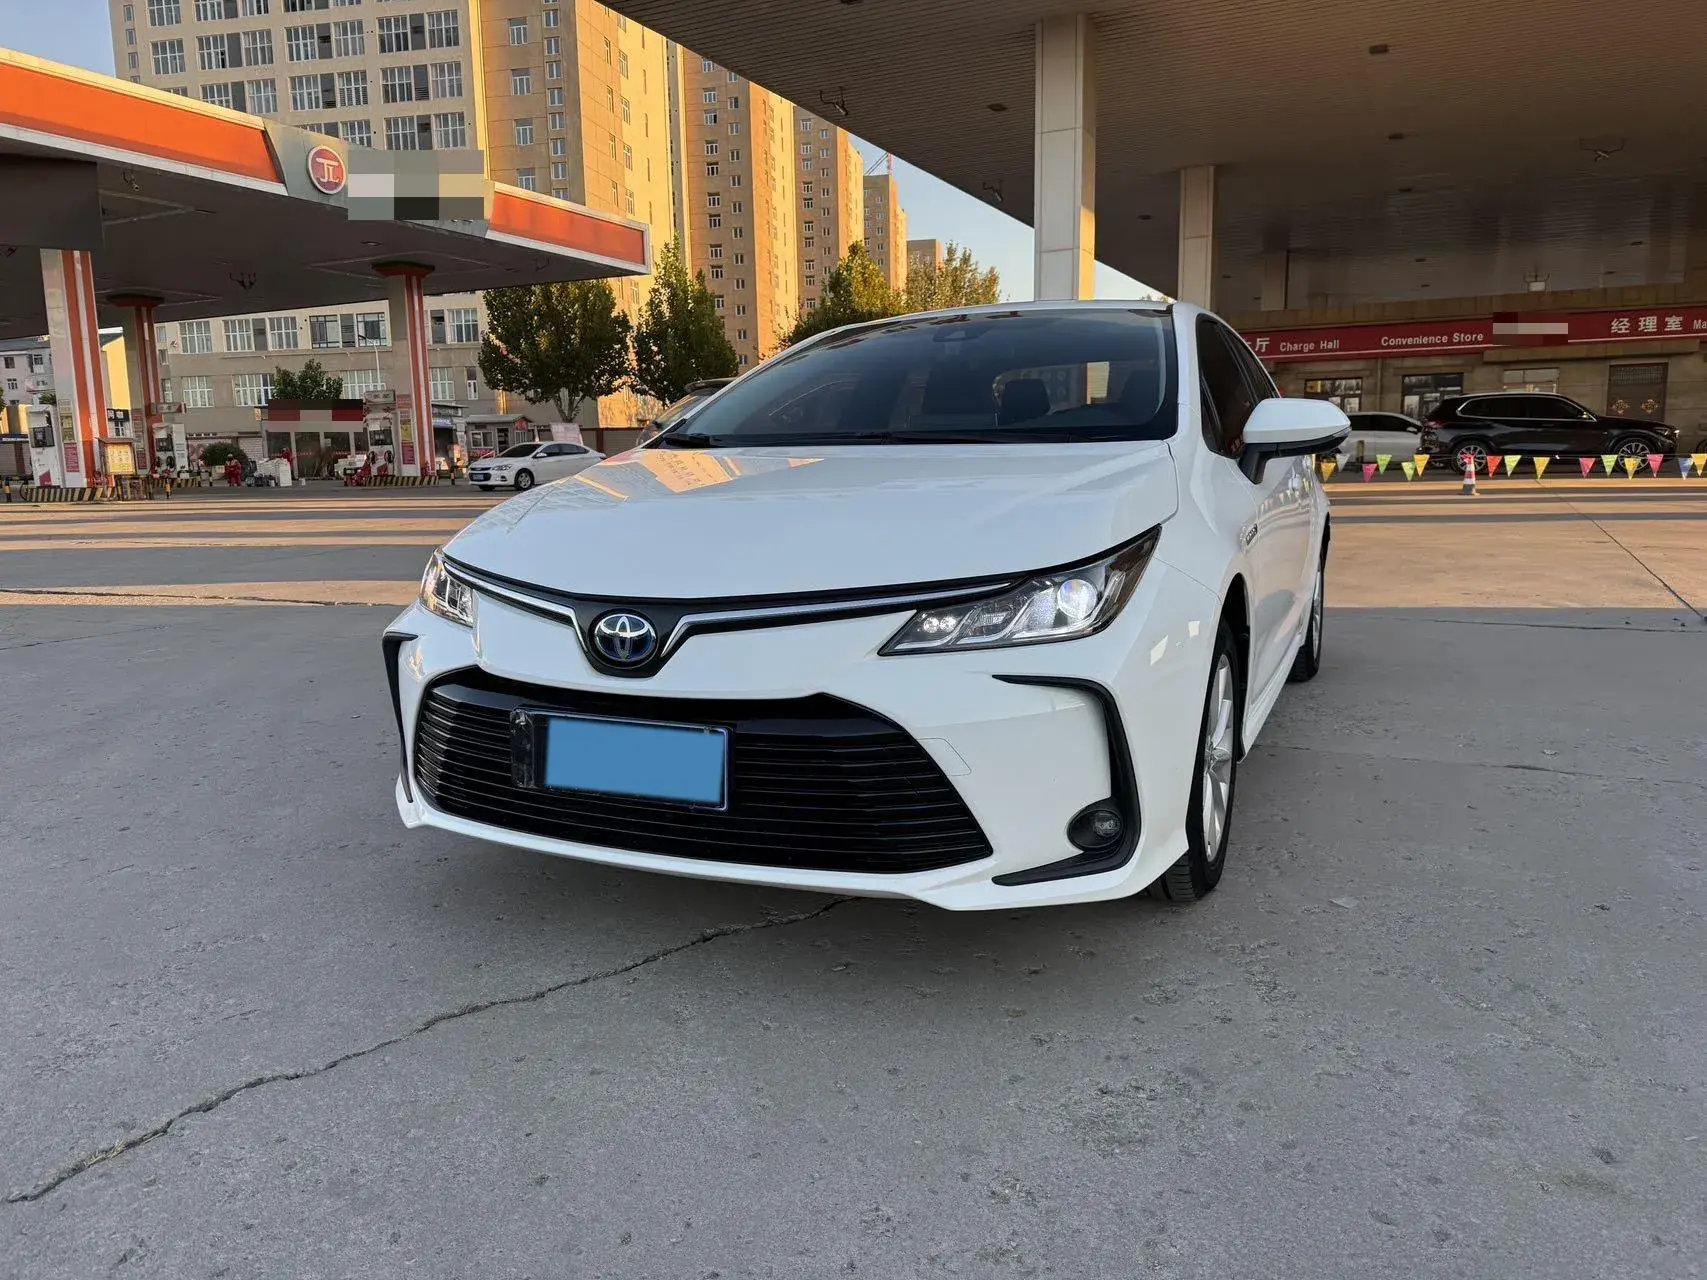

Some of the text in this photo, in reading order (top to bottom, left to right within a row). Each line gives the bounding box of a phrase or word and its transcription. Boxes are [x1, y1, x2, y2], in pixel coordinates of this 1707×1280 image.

[1610, 315, 1683, 333] 经理室
[1381, 332, 1483, 346] Convenience Store
[1279, 341, 1315, 353] Charge
[1320, 340, 1340, 350] Hall
